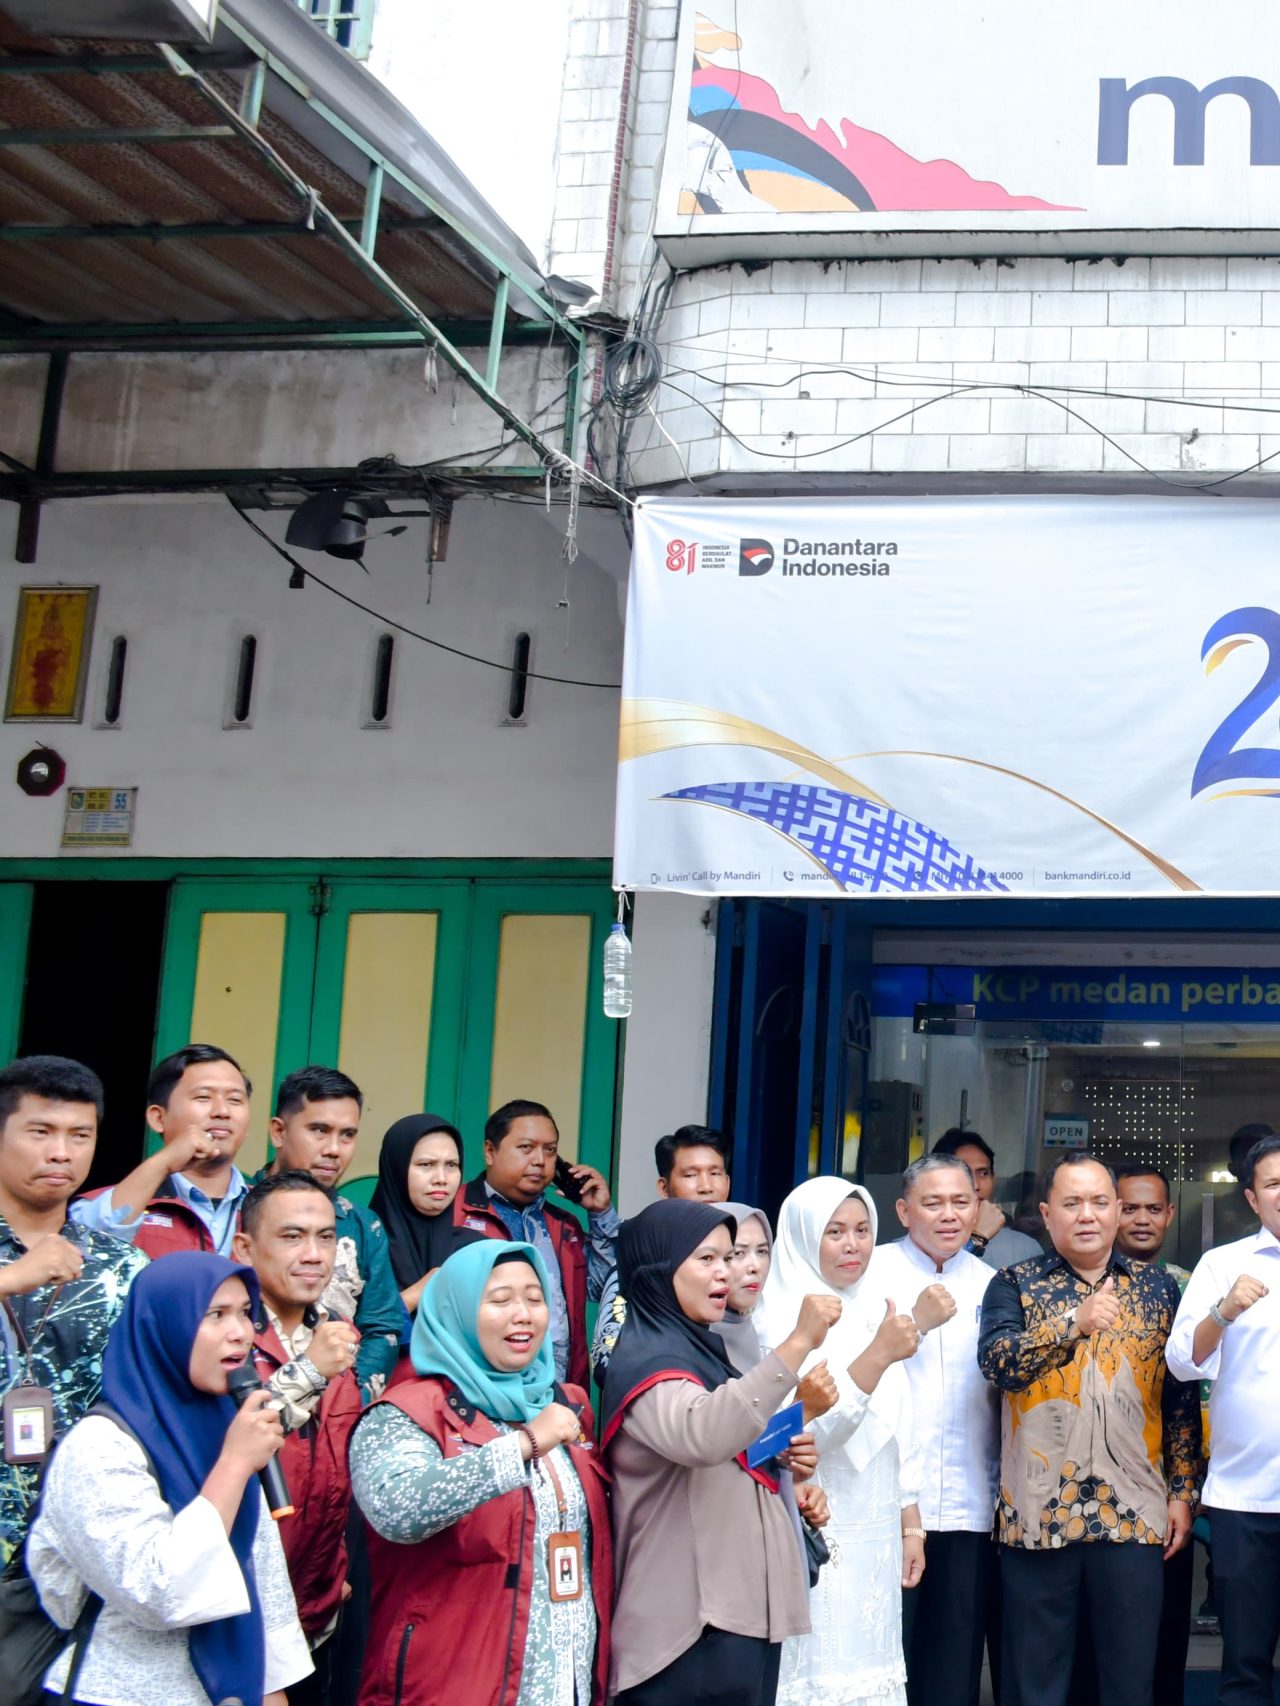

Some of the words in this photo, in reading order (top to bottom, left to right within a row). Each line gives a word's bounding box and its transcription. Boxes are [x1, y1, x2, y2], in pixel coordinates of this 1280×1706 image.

[783, 538, 898, 556] Danantara
[666, 539, 699, 576] 81
[782, 558, 890, 576] Indonesia
[667, 872, 690, 882] Livin'
[692, 871, 708, 881] Call
[710, 870, 721, 882] by
[724, 870, 761, 881] Mandiri
[801, 871, 840, 881] mandi
[1045, 870, 1131, 881] bankmandiri.co.id
[972, 973, 1040, 1003] KCP
[1050, 973, 1170, 1004] medan
[1050, 1126, 1083, 1137] OPEN
